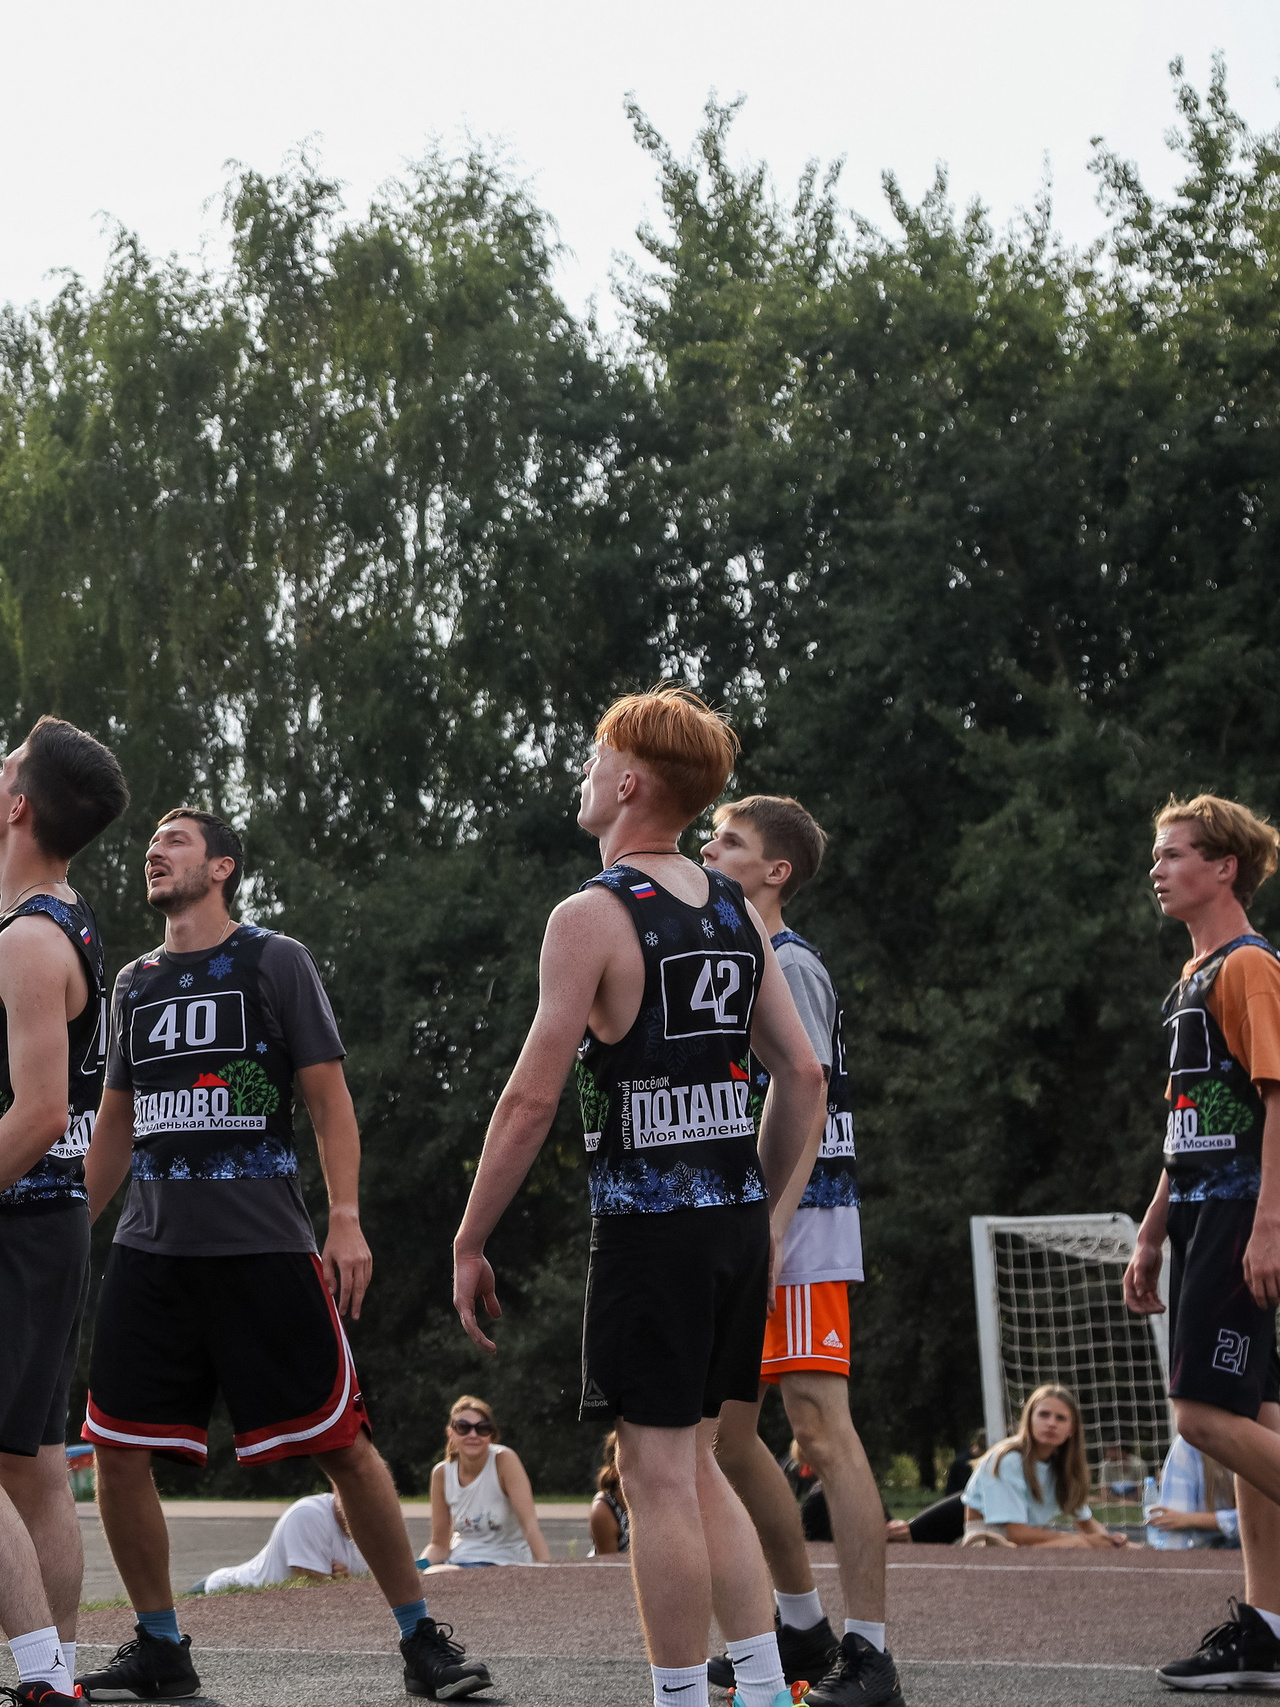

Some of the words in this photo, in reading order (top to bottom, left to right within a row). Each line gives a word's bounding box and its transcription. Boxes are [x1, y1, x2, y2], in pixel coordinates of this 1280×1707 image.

[690, 959, 740, 1024] 42
[148, 1000, 217, 1051] 40
[632, 1076, 670, 1091] посёлок
[617, 1080, 632, 1150] коттеджный
[210, 1117, 263, 1129] Москва
[640, 1130, 676, 1145] Моя
[1184, 1138, 1232, 1150] Москва
[1212, 1328, 1251, 1376] 21
[583, 1399, 609, 1408] Reebok
